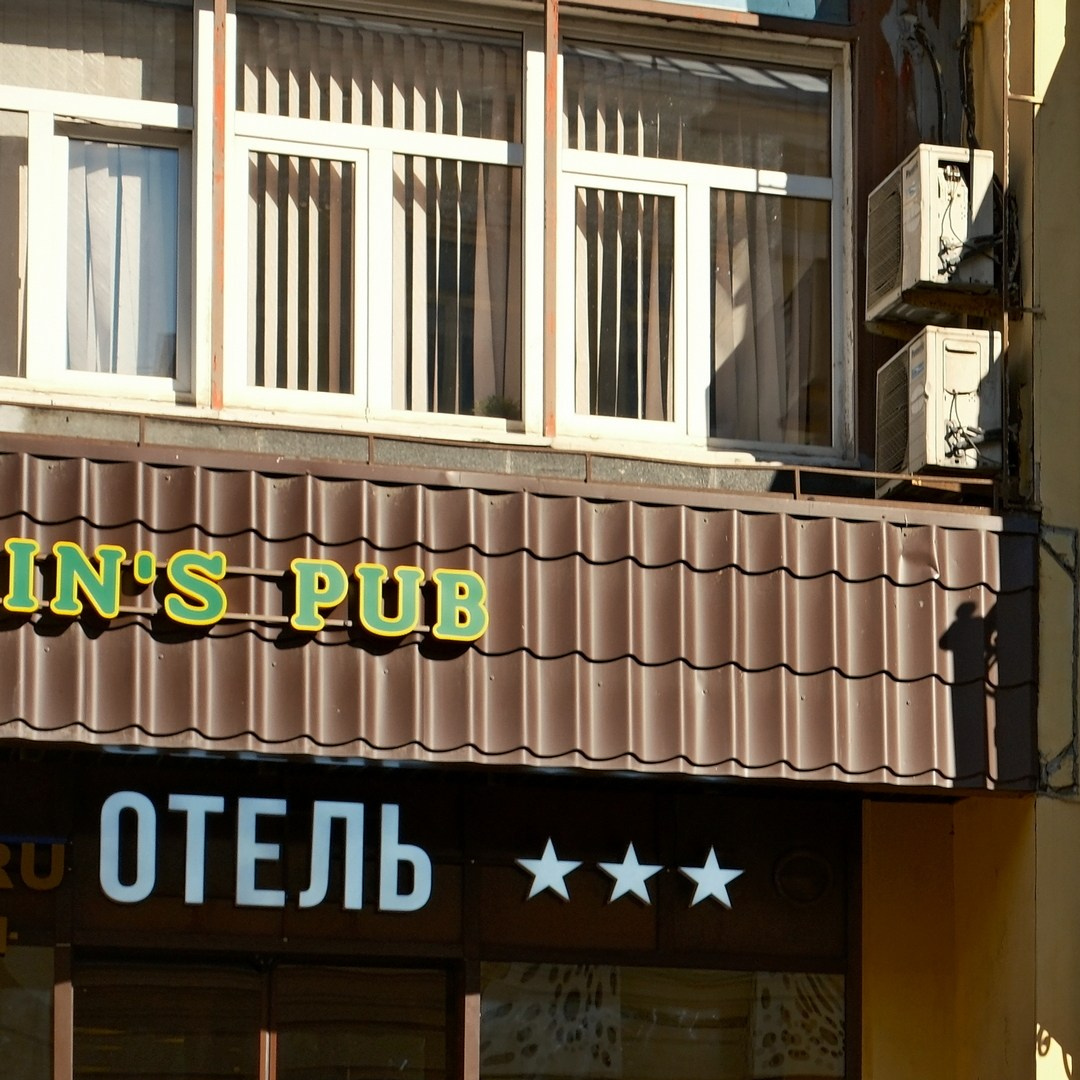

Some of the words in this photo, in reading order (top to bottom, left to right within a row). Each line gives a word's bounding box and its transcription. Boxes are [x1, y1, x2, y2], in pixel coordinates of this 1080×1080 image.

[2, 537, 228, 626] IN'S
[289, 558, 490, 642] PUB
[99, 790, 433, 912] ОТЕЛЬ
